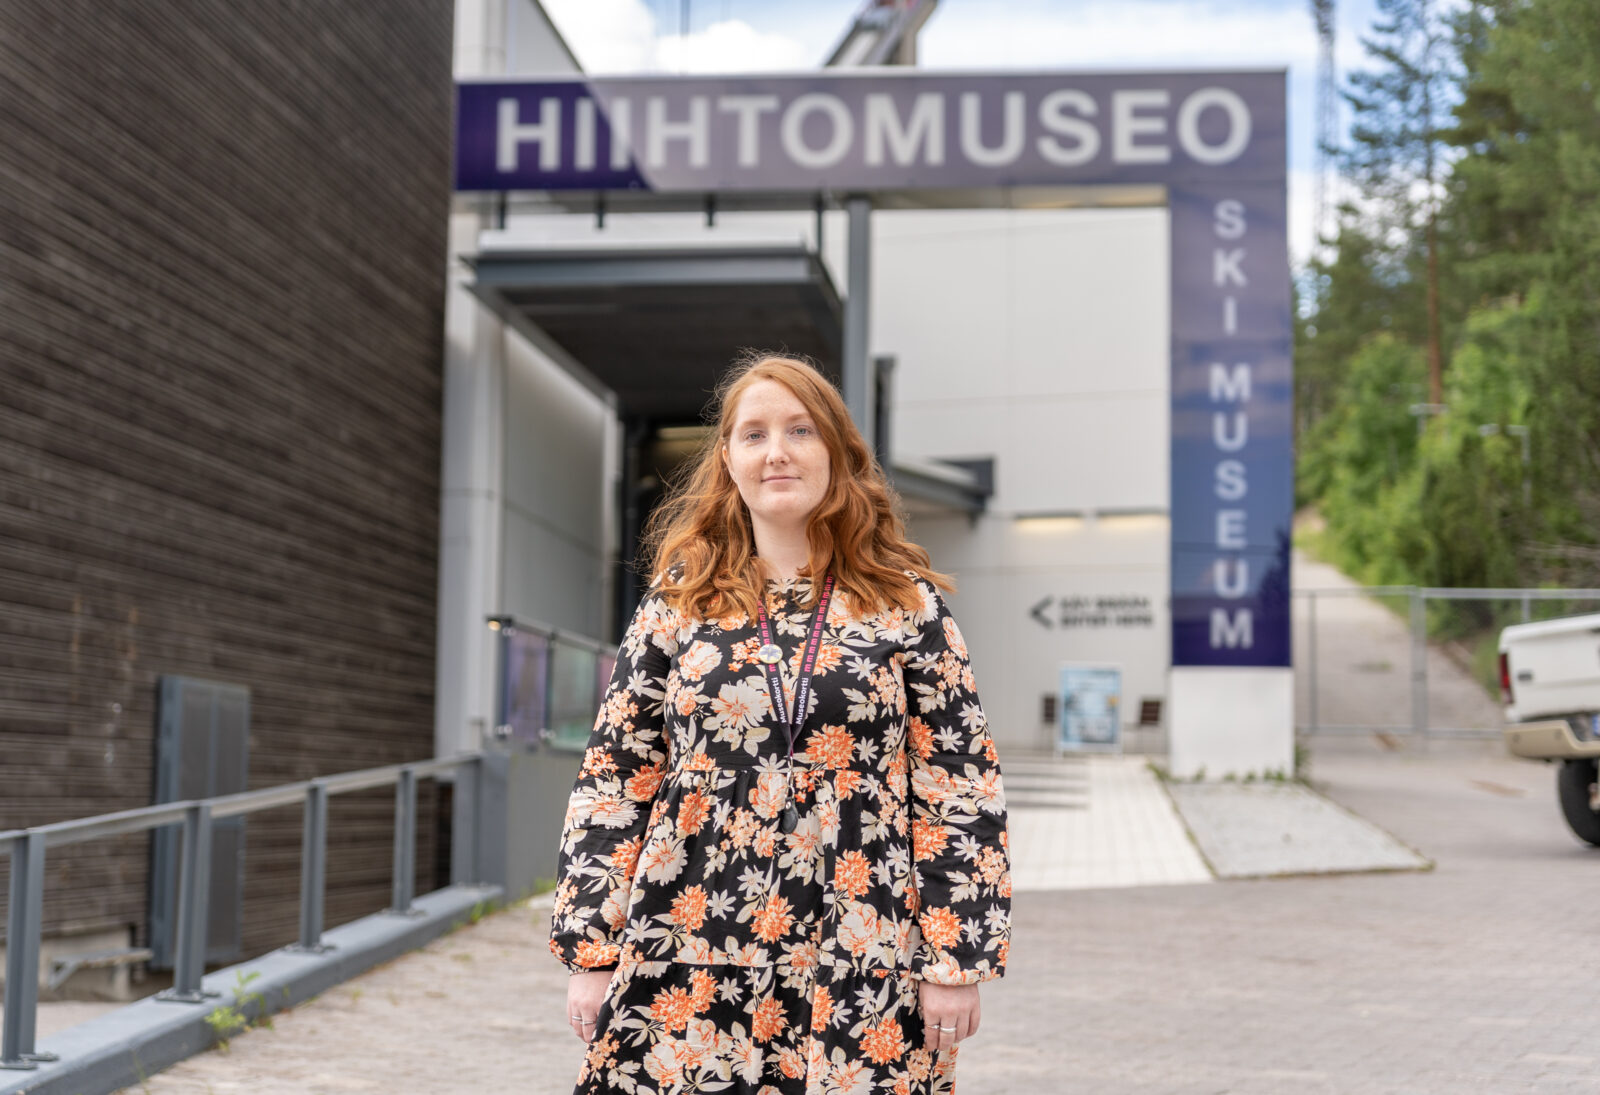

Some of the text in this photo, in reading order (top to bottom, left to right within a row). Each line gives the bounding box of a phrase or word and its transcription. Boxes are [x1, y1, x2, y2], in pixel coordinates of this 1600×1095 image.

[496, 88, 1252, 173] HIIHTOMUSEO
[1209, 199, 1254, 650] SKI MUSEUM
[771, 677, 787, 723] Museokortti
[795, 677, 809, 725] Museokortti
